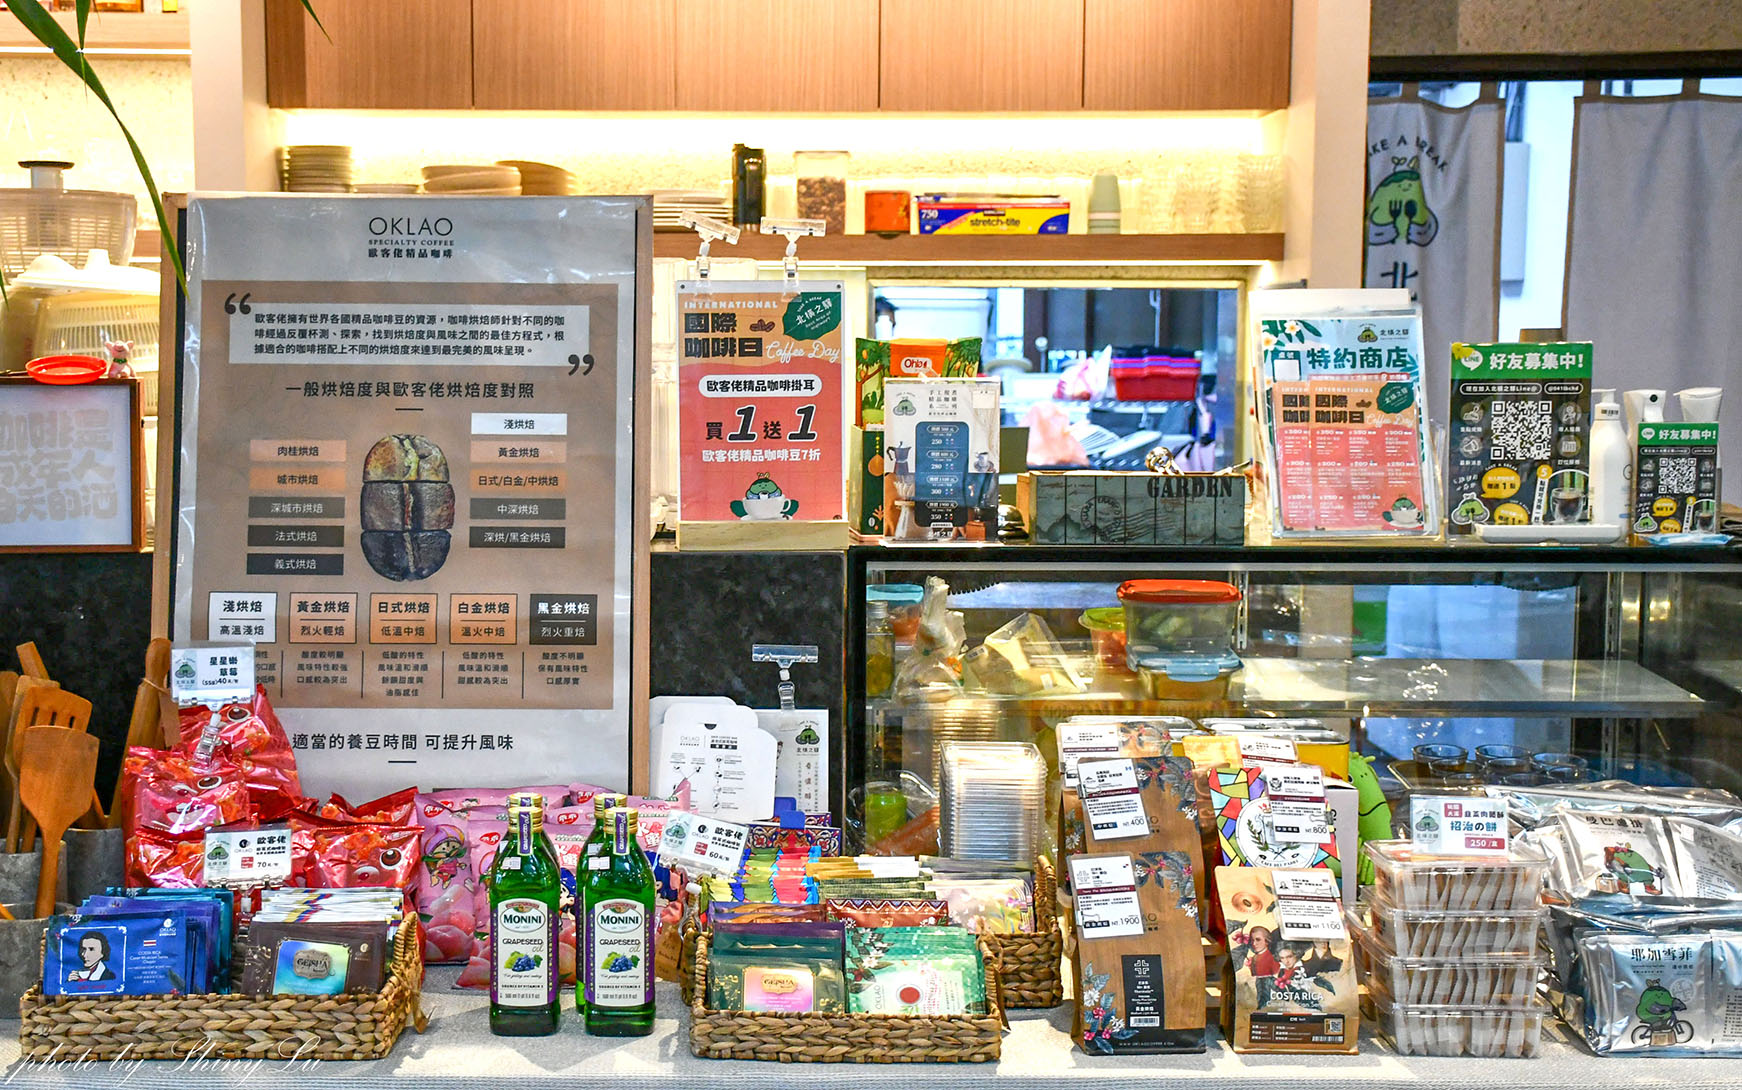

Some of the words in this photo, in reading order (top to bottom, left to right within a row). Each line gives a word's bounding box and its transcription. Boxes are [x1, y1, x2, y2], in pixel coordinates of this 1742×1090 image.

[1397, 136, 1407, 146] A
[921, 210, 938, 219] 750
[369, 217, 453, 236] OKLAO
[368, 248, 452, 259] 歐客佬精品咖啡
[684, 301, 778, 309] INTERNATIONAL
[684, 313, 737, 333] 國際
[684, 338, 763, 358] 咖啡日
[766, 341, 805, 364] Coffee
[809, 341, 841, 362] Day
[1307, 347, 1408, 369] 特約商店
[1489, 352, 1584, 370] 好友募集中!
[286, 381, 535, 399] 一般烘焙度與歐客佬烘焙度對照
[706, 380, 815, 392] 歐客佬精品咖啡掛耳
[1315, 411, 1364, 424] 咖啡日
[503, 419, 535, 430] 淺烘焙
[277, 445, 319, 458] 肉桂烘焙
[497, 446, 540, 459] 黃金烘焙
[702, 449, 821, 462] 歐客佬精品咖啡豆7折
[277, 473, 319, 486] 城市烘焙
[478, 474, 559, 487] 日式/白金/中烘焙
[270, 502, 324, 515] 深城市烘焙
[497, 503, 539, 516] 中深烘焙
[286, 530, 317, 543] 法式烘焙
[483, 532, 551, 544] 深烘/黑金烘焙
[274, 558, 317, 570] 義式烘焙
[223, 600, 264, 614] 淺烘焙
[297, 600, 350, 614] 黃金烘焙
[378, 601, 430, 614] 日式烘焙
[457, 601, 510, 615] 白金烘焙
[537, 601, 590, 616] 黑金烘焙
[219, 624, 265, 637] 高溫淺焙
[300, 625, 345, 638] 烈火輕焙
[381, 625, 425, 638] 低溫中焙
[461, 625, 505, 638] 溫火中焙
[540, 625, 585, 639] 烈火重焙
[292, 734, 418, 751] 適當的養豆時間
[425, 734, 514, 751] 可提升風味
[1131, 818, 1145, 826] 400
[503, 914, 542, 925] MONINI
[600, 914, 639, 925] MONINI
[1120, 916, 1140, 925] 1900
[532, 944, 544, 952] oil
[629, 944, 641, 952] oil
[1631, 947, 1692, 961] 耶加雪菲
[1270, 990, 1301, 1001] COSTA
[1301, 991, 1323, 1001] RICA
